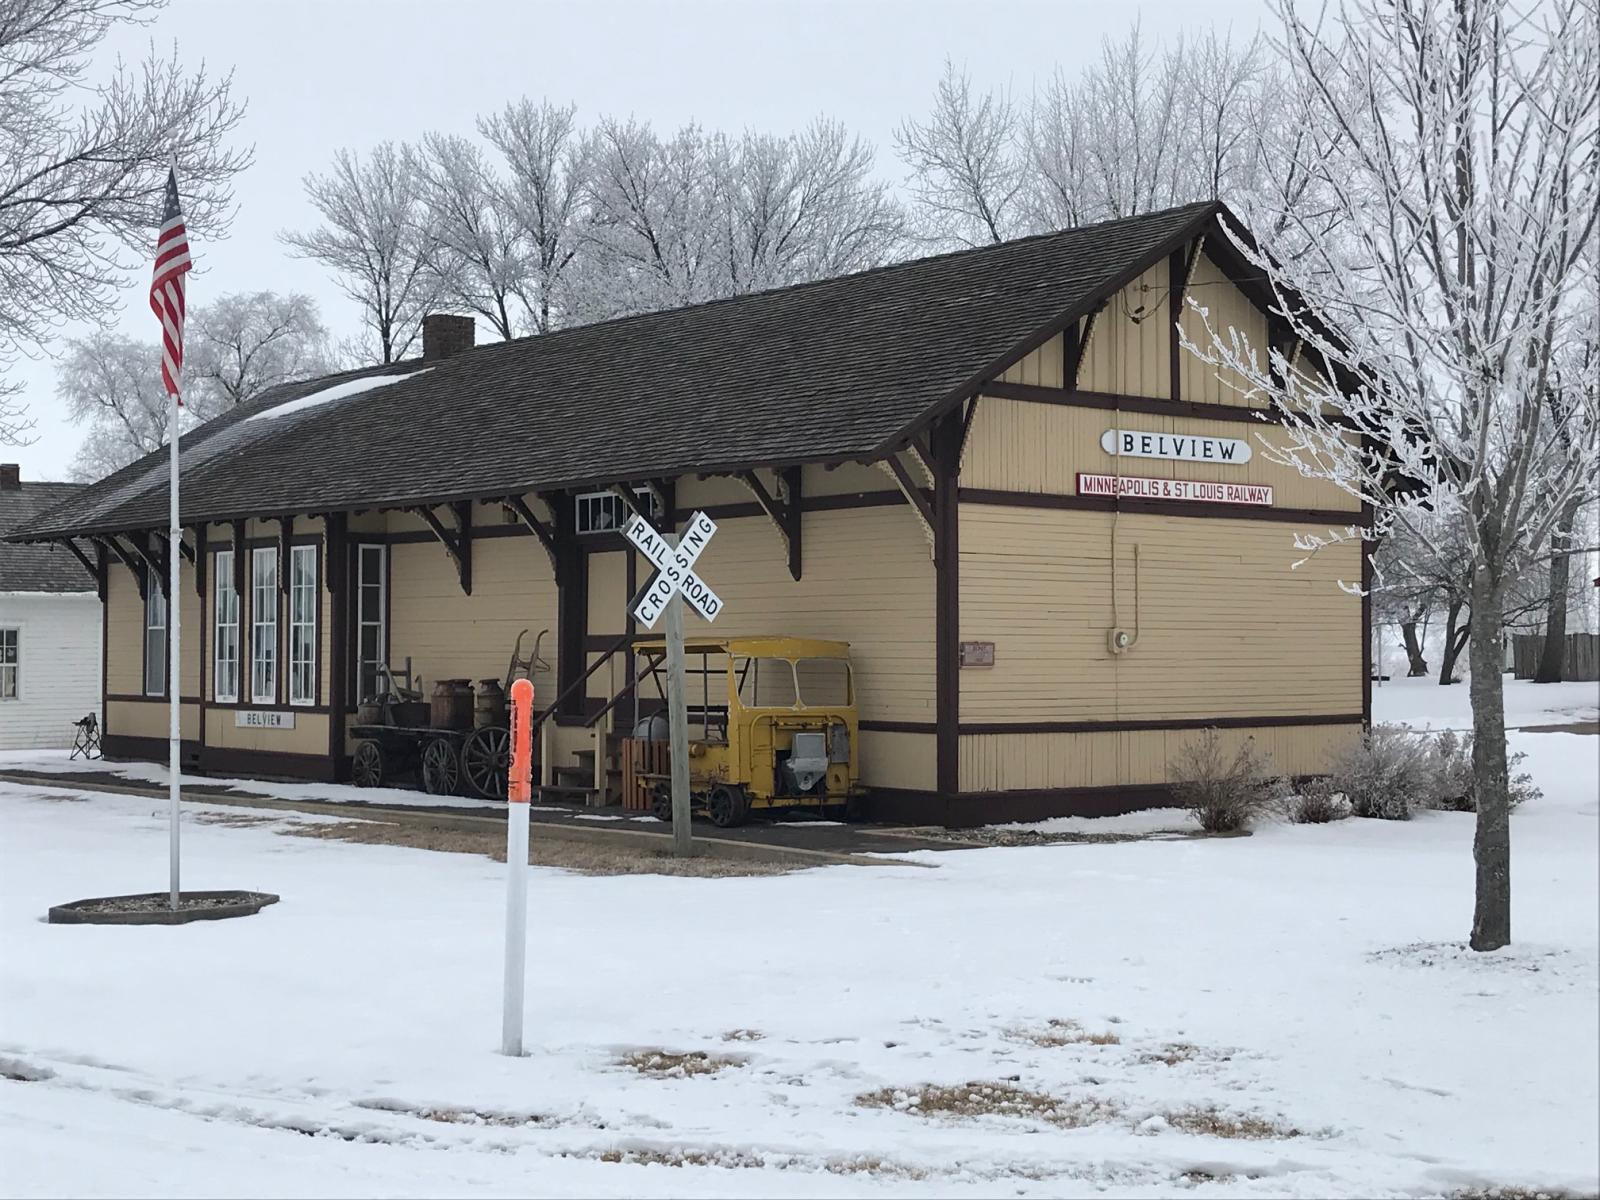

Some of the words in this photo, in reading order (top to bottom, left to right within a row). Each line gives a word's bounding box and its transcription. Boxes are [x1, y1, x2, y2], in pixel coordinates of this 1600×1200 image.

[1123, 434, 1236, 460] BELVIEW
[1083, 476, 1159, 497] MINNEAPOLIS
[1163, 482, 1171, 496] &
[1174, 483, 1189, 498] ST
[1193, 485, 1224, 500] LOUIS
[1227, 487, 1270, 503] RAILWAY
[632, 522, 666, 566] RAIL
[681, 574, 718, 615] ROAD
[640, 518, 712, 622] CROSSING
[247, 713, 281, 726] BELVIEW
